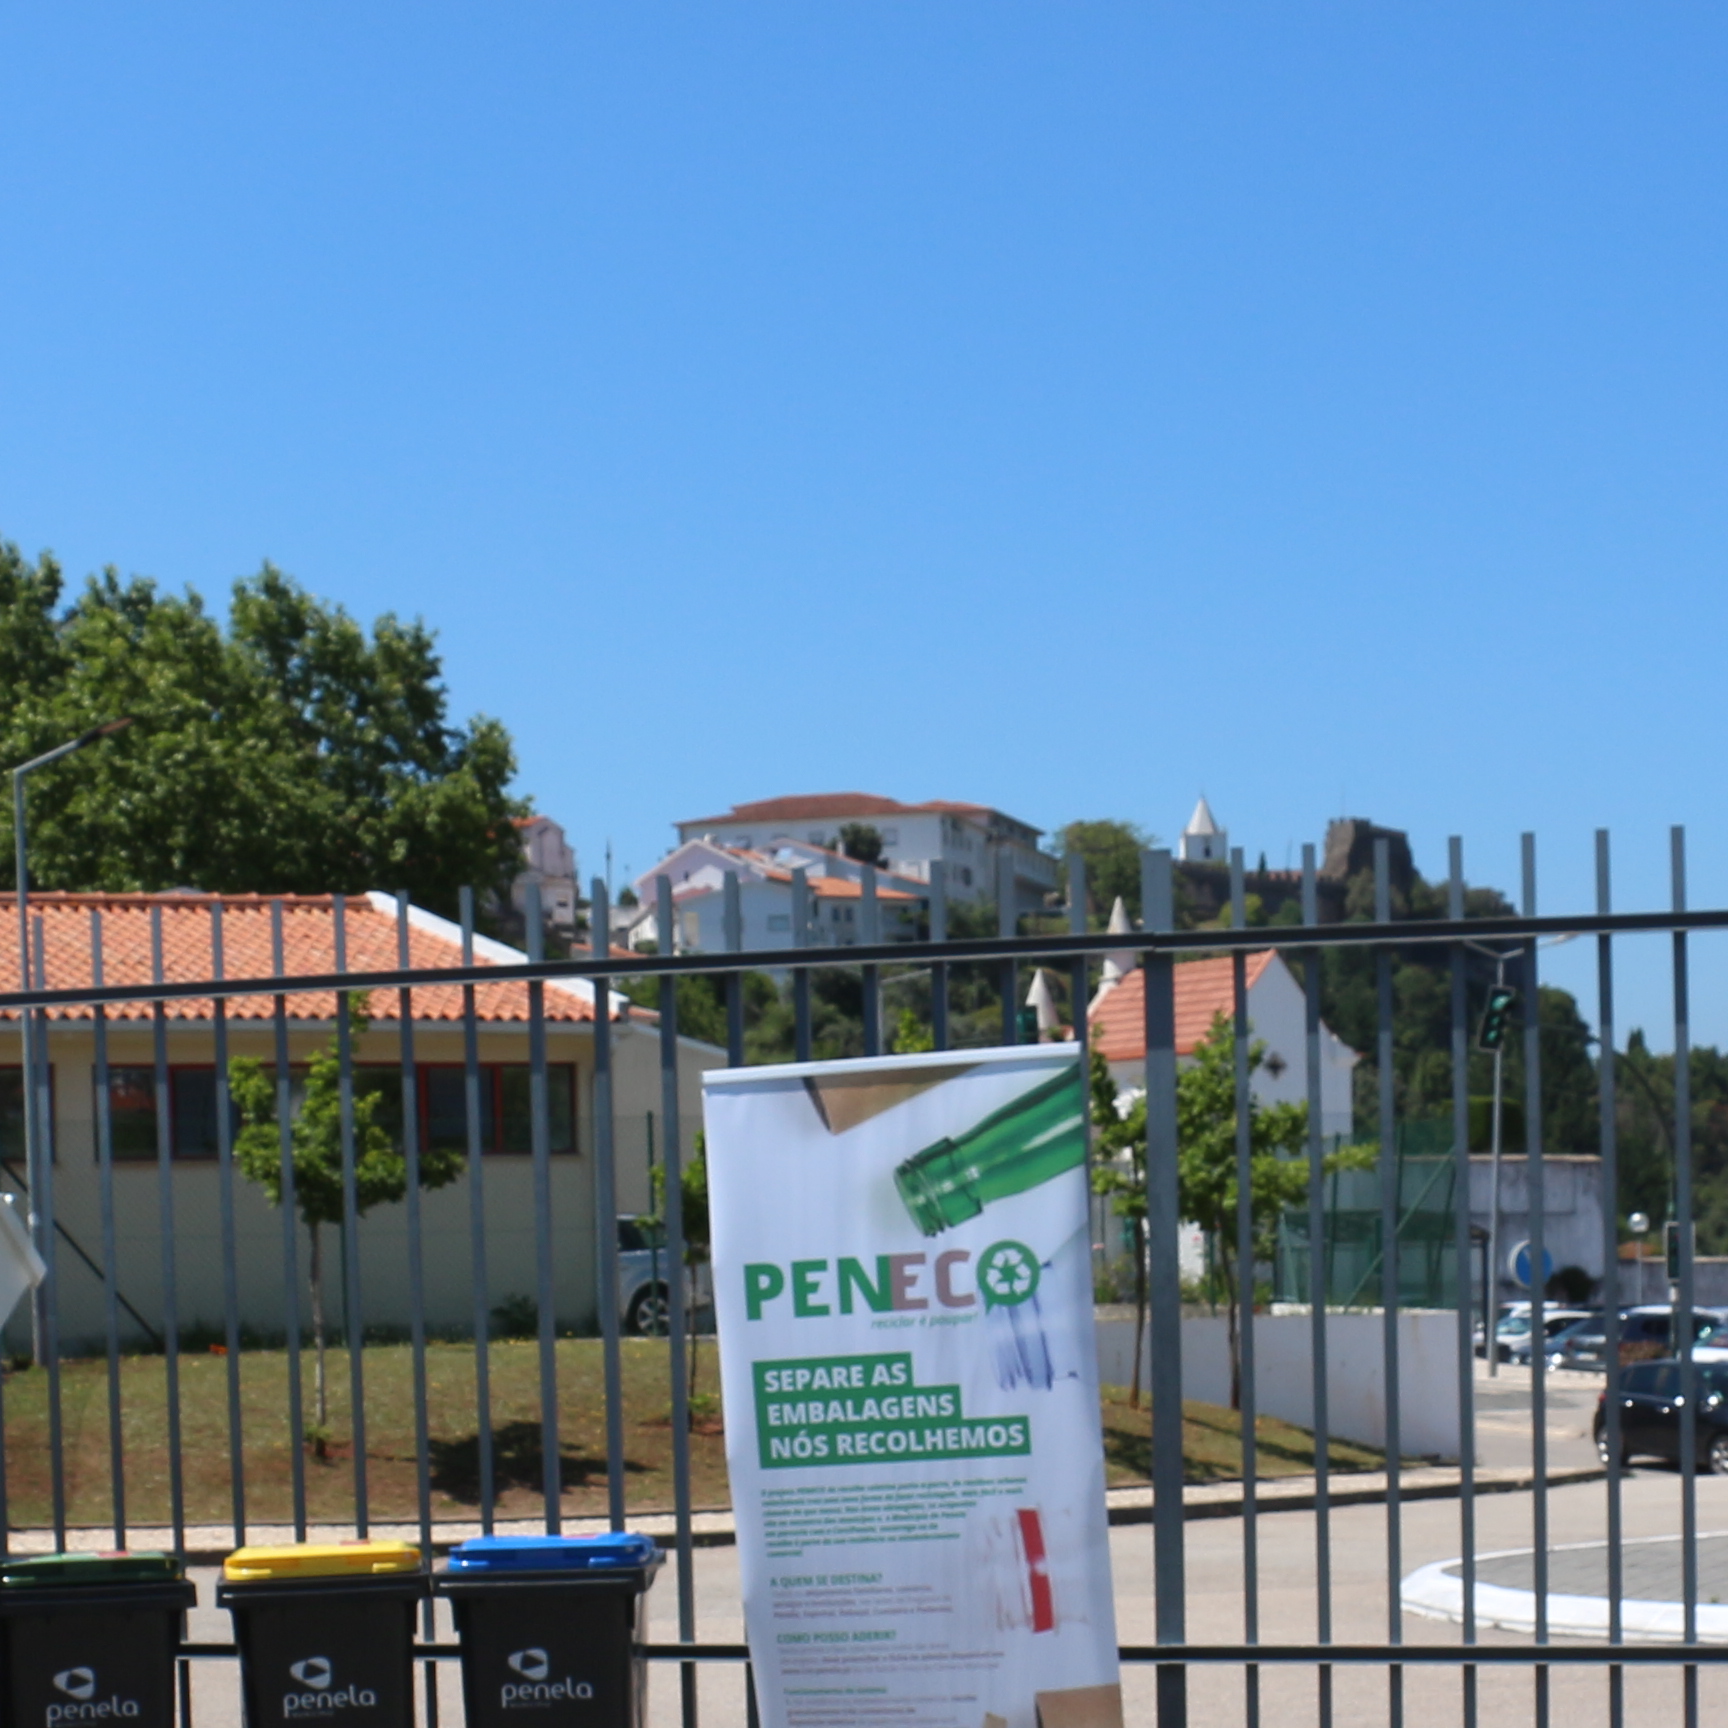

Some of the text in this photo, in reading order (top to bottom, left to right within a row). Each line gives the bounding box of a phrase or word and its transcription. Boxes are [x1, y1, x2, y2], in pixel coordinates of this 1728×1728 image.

[743, 1240, 1041, 1321] PENECO
[763, 1362, 908, 1393] SEPARE AS
[766, 1393, 955, 1427] EMBALAGENS
[769, 1424, 1025, 1459] NÓS RECOLHEMOS
[283, 1684, 377, 1718] penela
[500, 1676, 594, 1709] penela
[46, 1695, 140, 1728] penela
